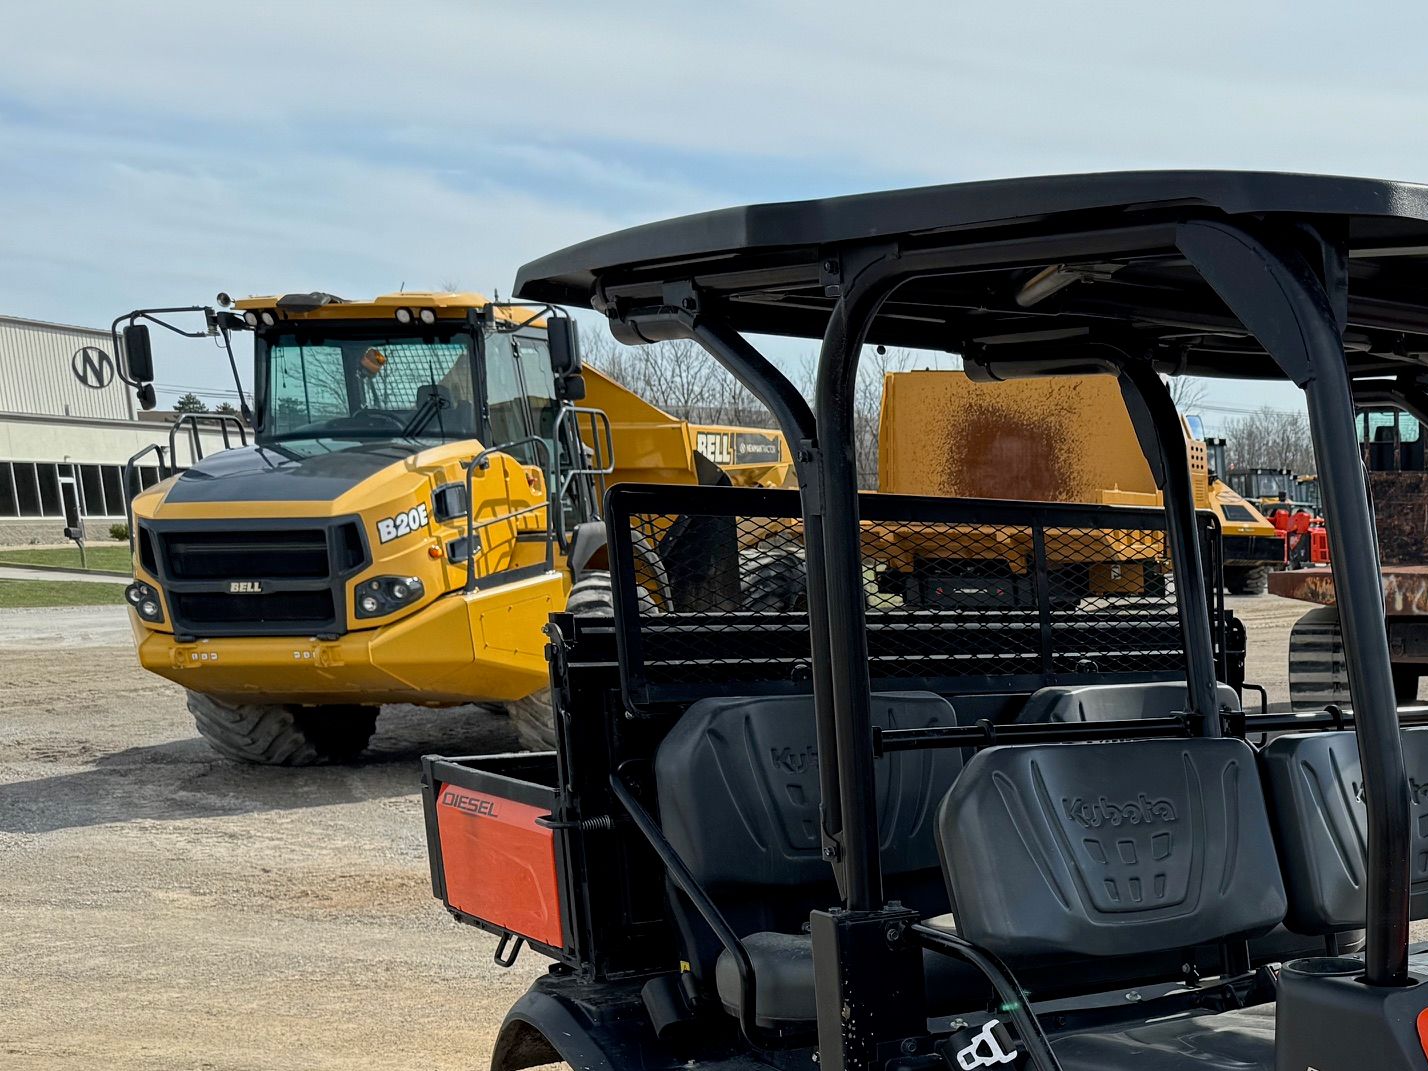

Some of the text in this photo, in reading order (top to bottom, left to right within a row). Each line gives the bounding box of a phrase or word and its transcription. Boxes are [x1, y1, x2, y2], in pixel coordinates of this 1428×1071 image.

[77, 347, 110, 388] N
[697, 432, 731, 463] BELL
[377, 502, 429, 544] B20E
[230, 581, 262, 593] BELL
[442, 791, 499, 818] DIESEL
[1061, 793, 1177, 828] Kubota
